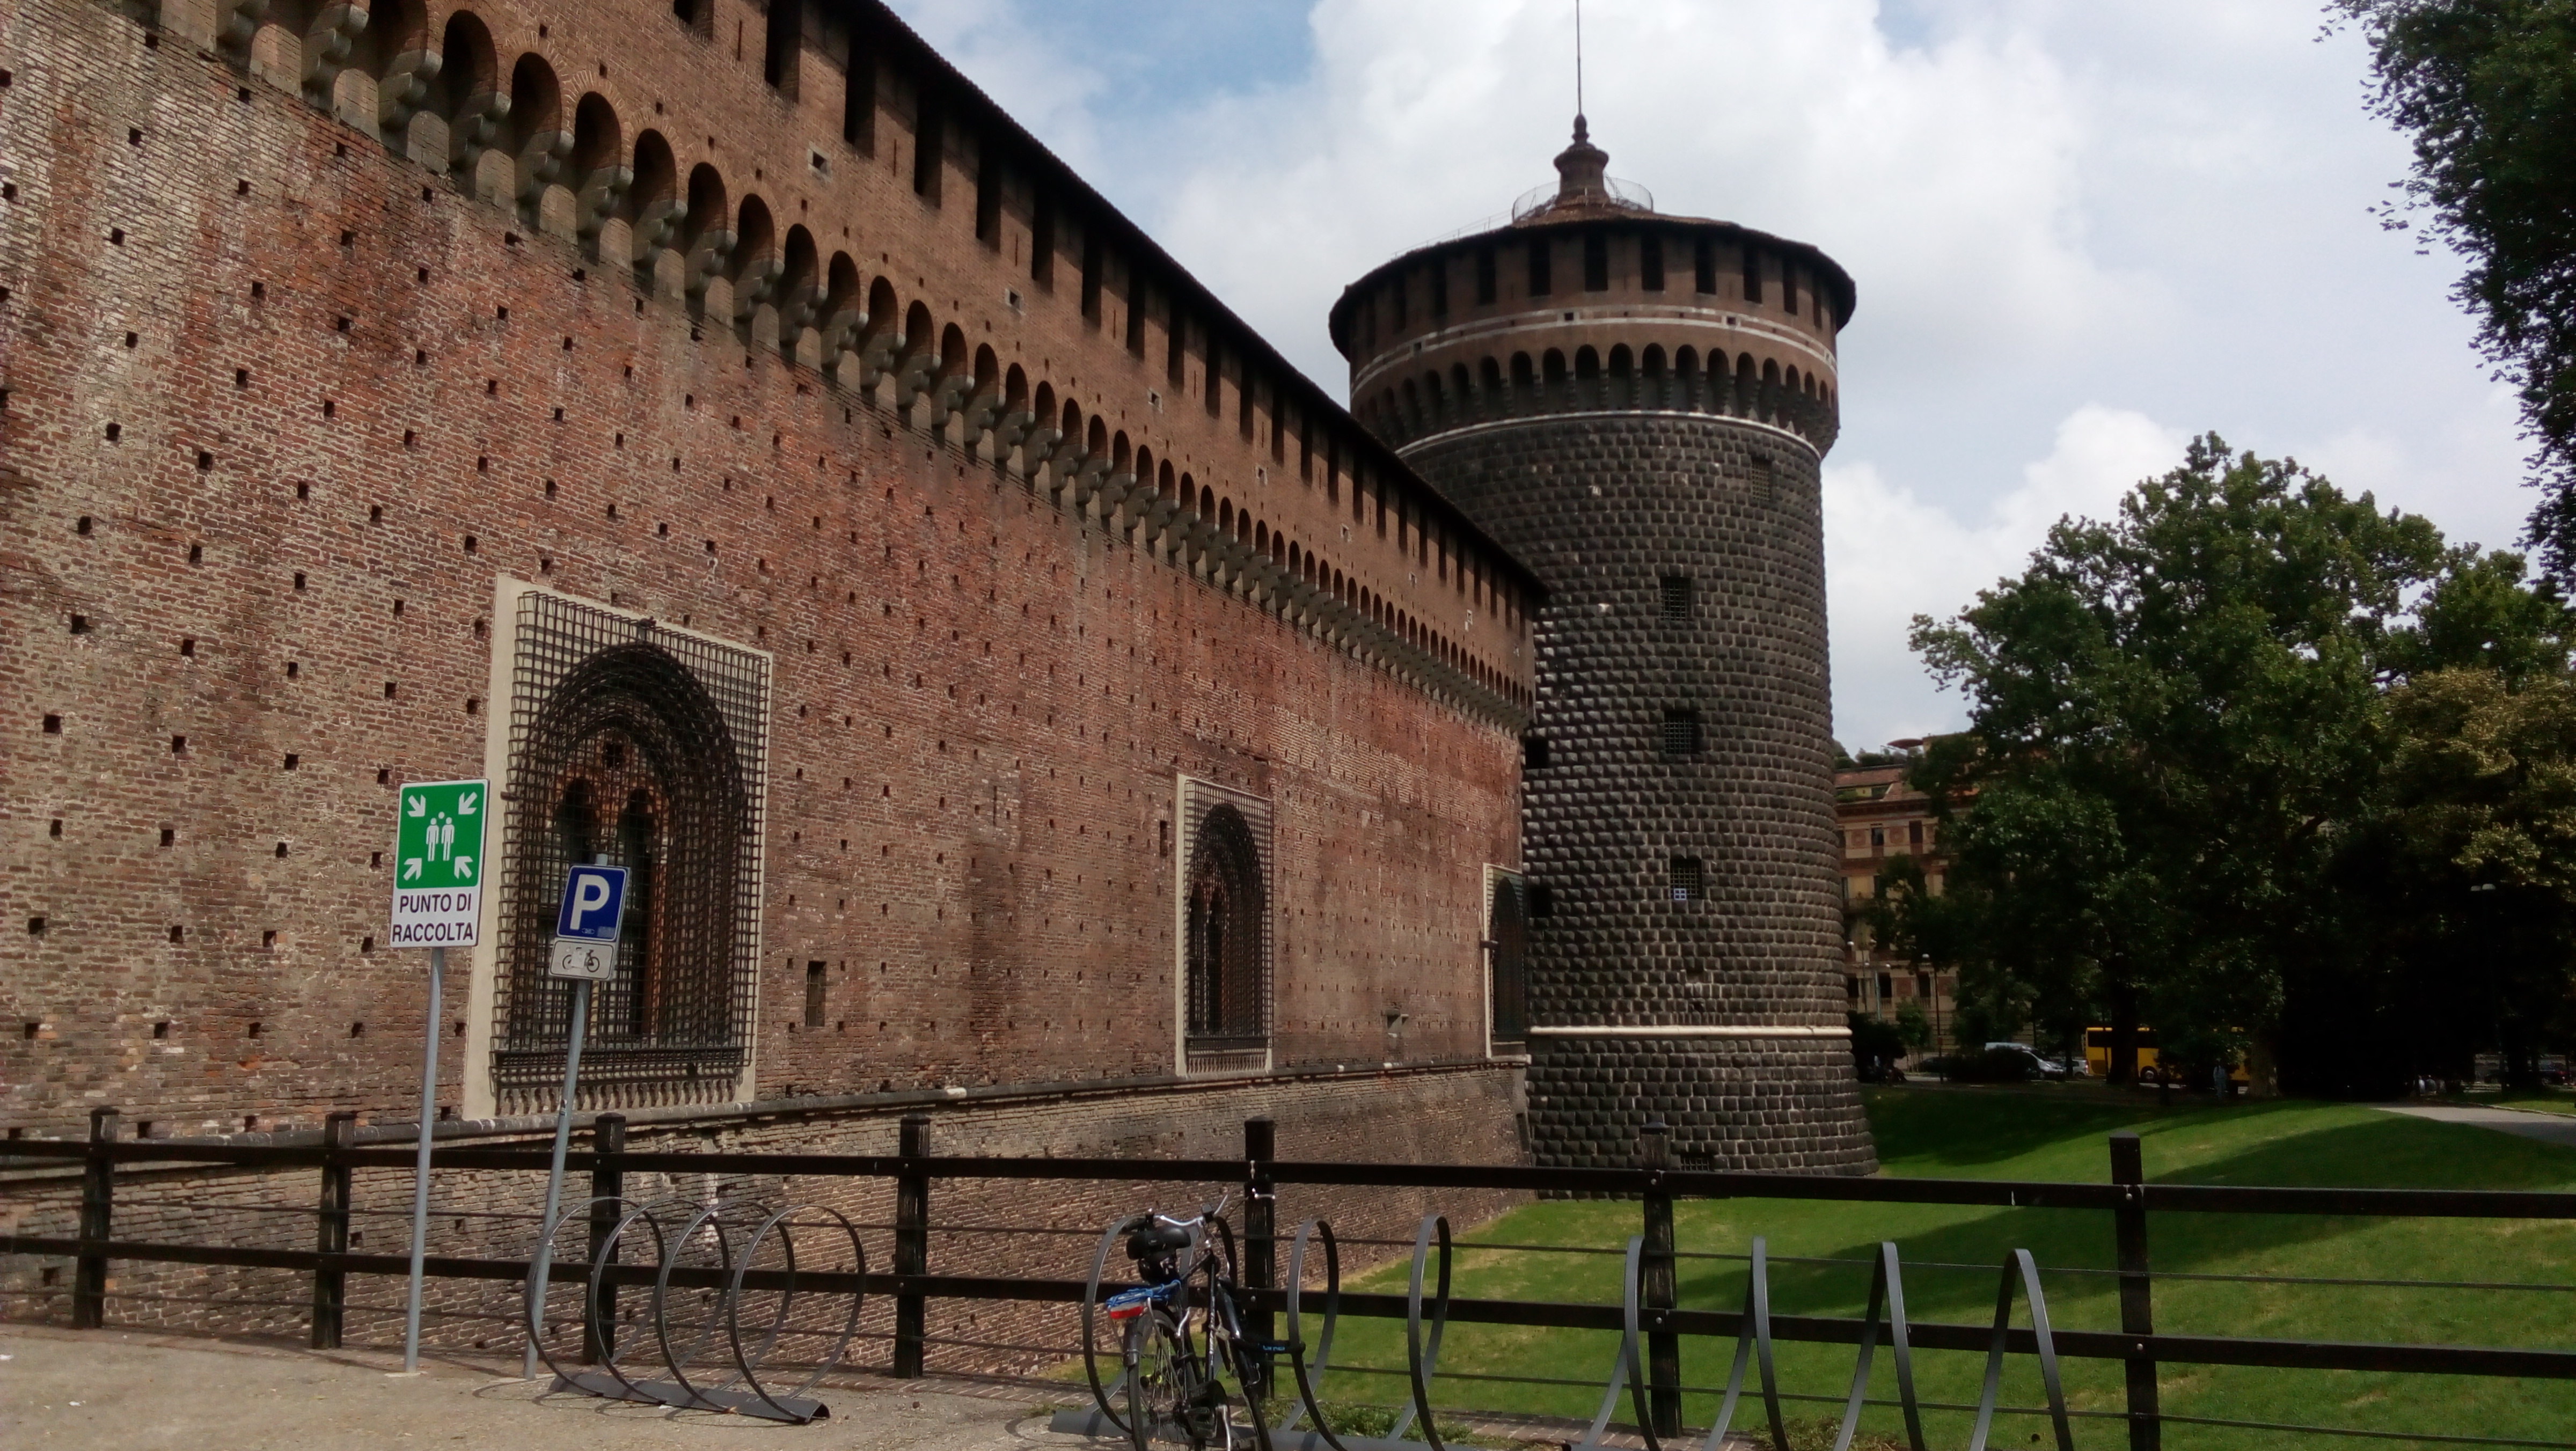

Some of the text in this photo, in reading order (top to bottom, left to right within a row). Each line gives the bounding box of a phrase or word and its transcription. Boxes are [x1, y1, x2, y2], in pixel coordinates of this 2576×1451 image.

[399, 893, 471, 913] PUNTO DI
[570, 874, 610, 930] P
[392, 922, 473, 942] RACCOLTA
